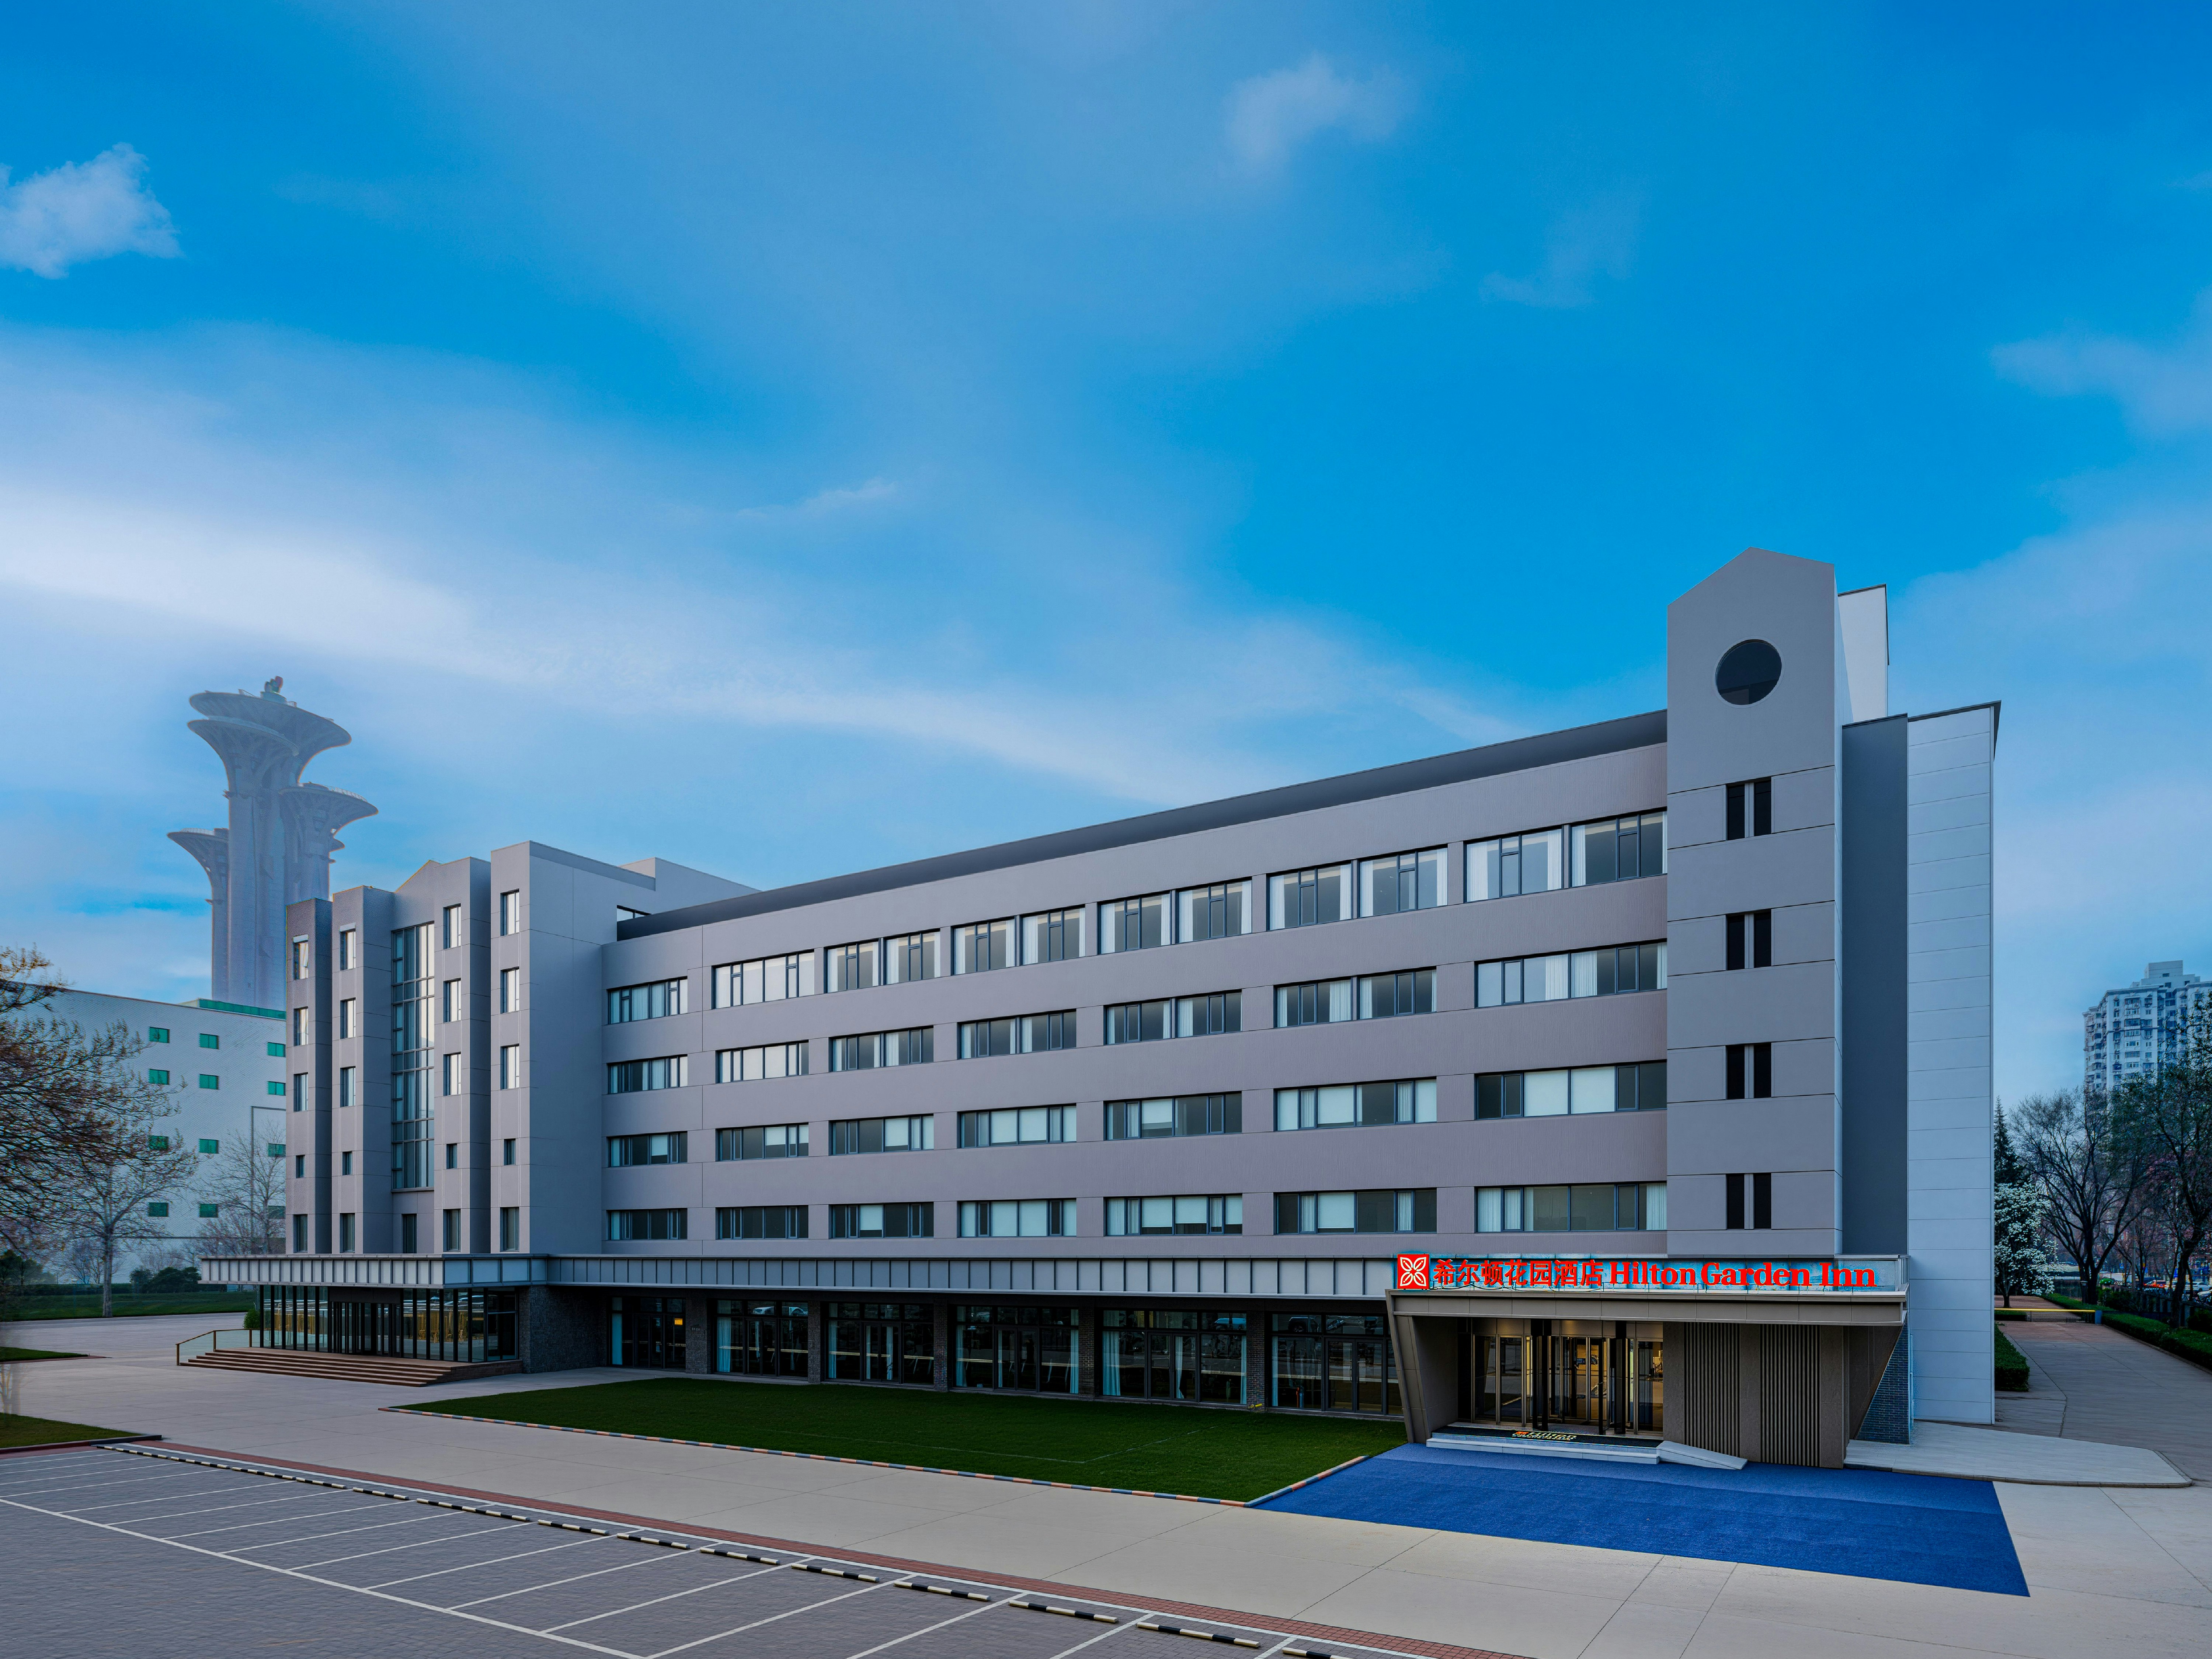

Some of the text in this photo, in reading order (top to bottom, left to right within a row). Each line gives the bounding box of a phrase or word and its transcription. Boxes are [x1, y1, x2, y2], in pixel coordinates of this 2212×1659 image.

[1433, 1259, 1603, 1286] 希尔顿花园酒店
[1609, 1262, 1877, 1287] Hilton Garden Inn
